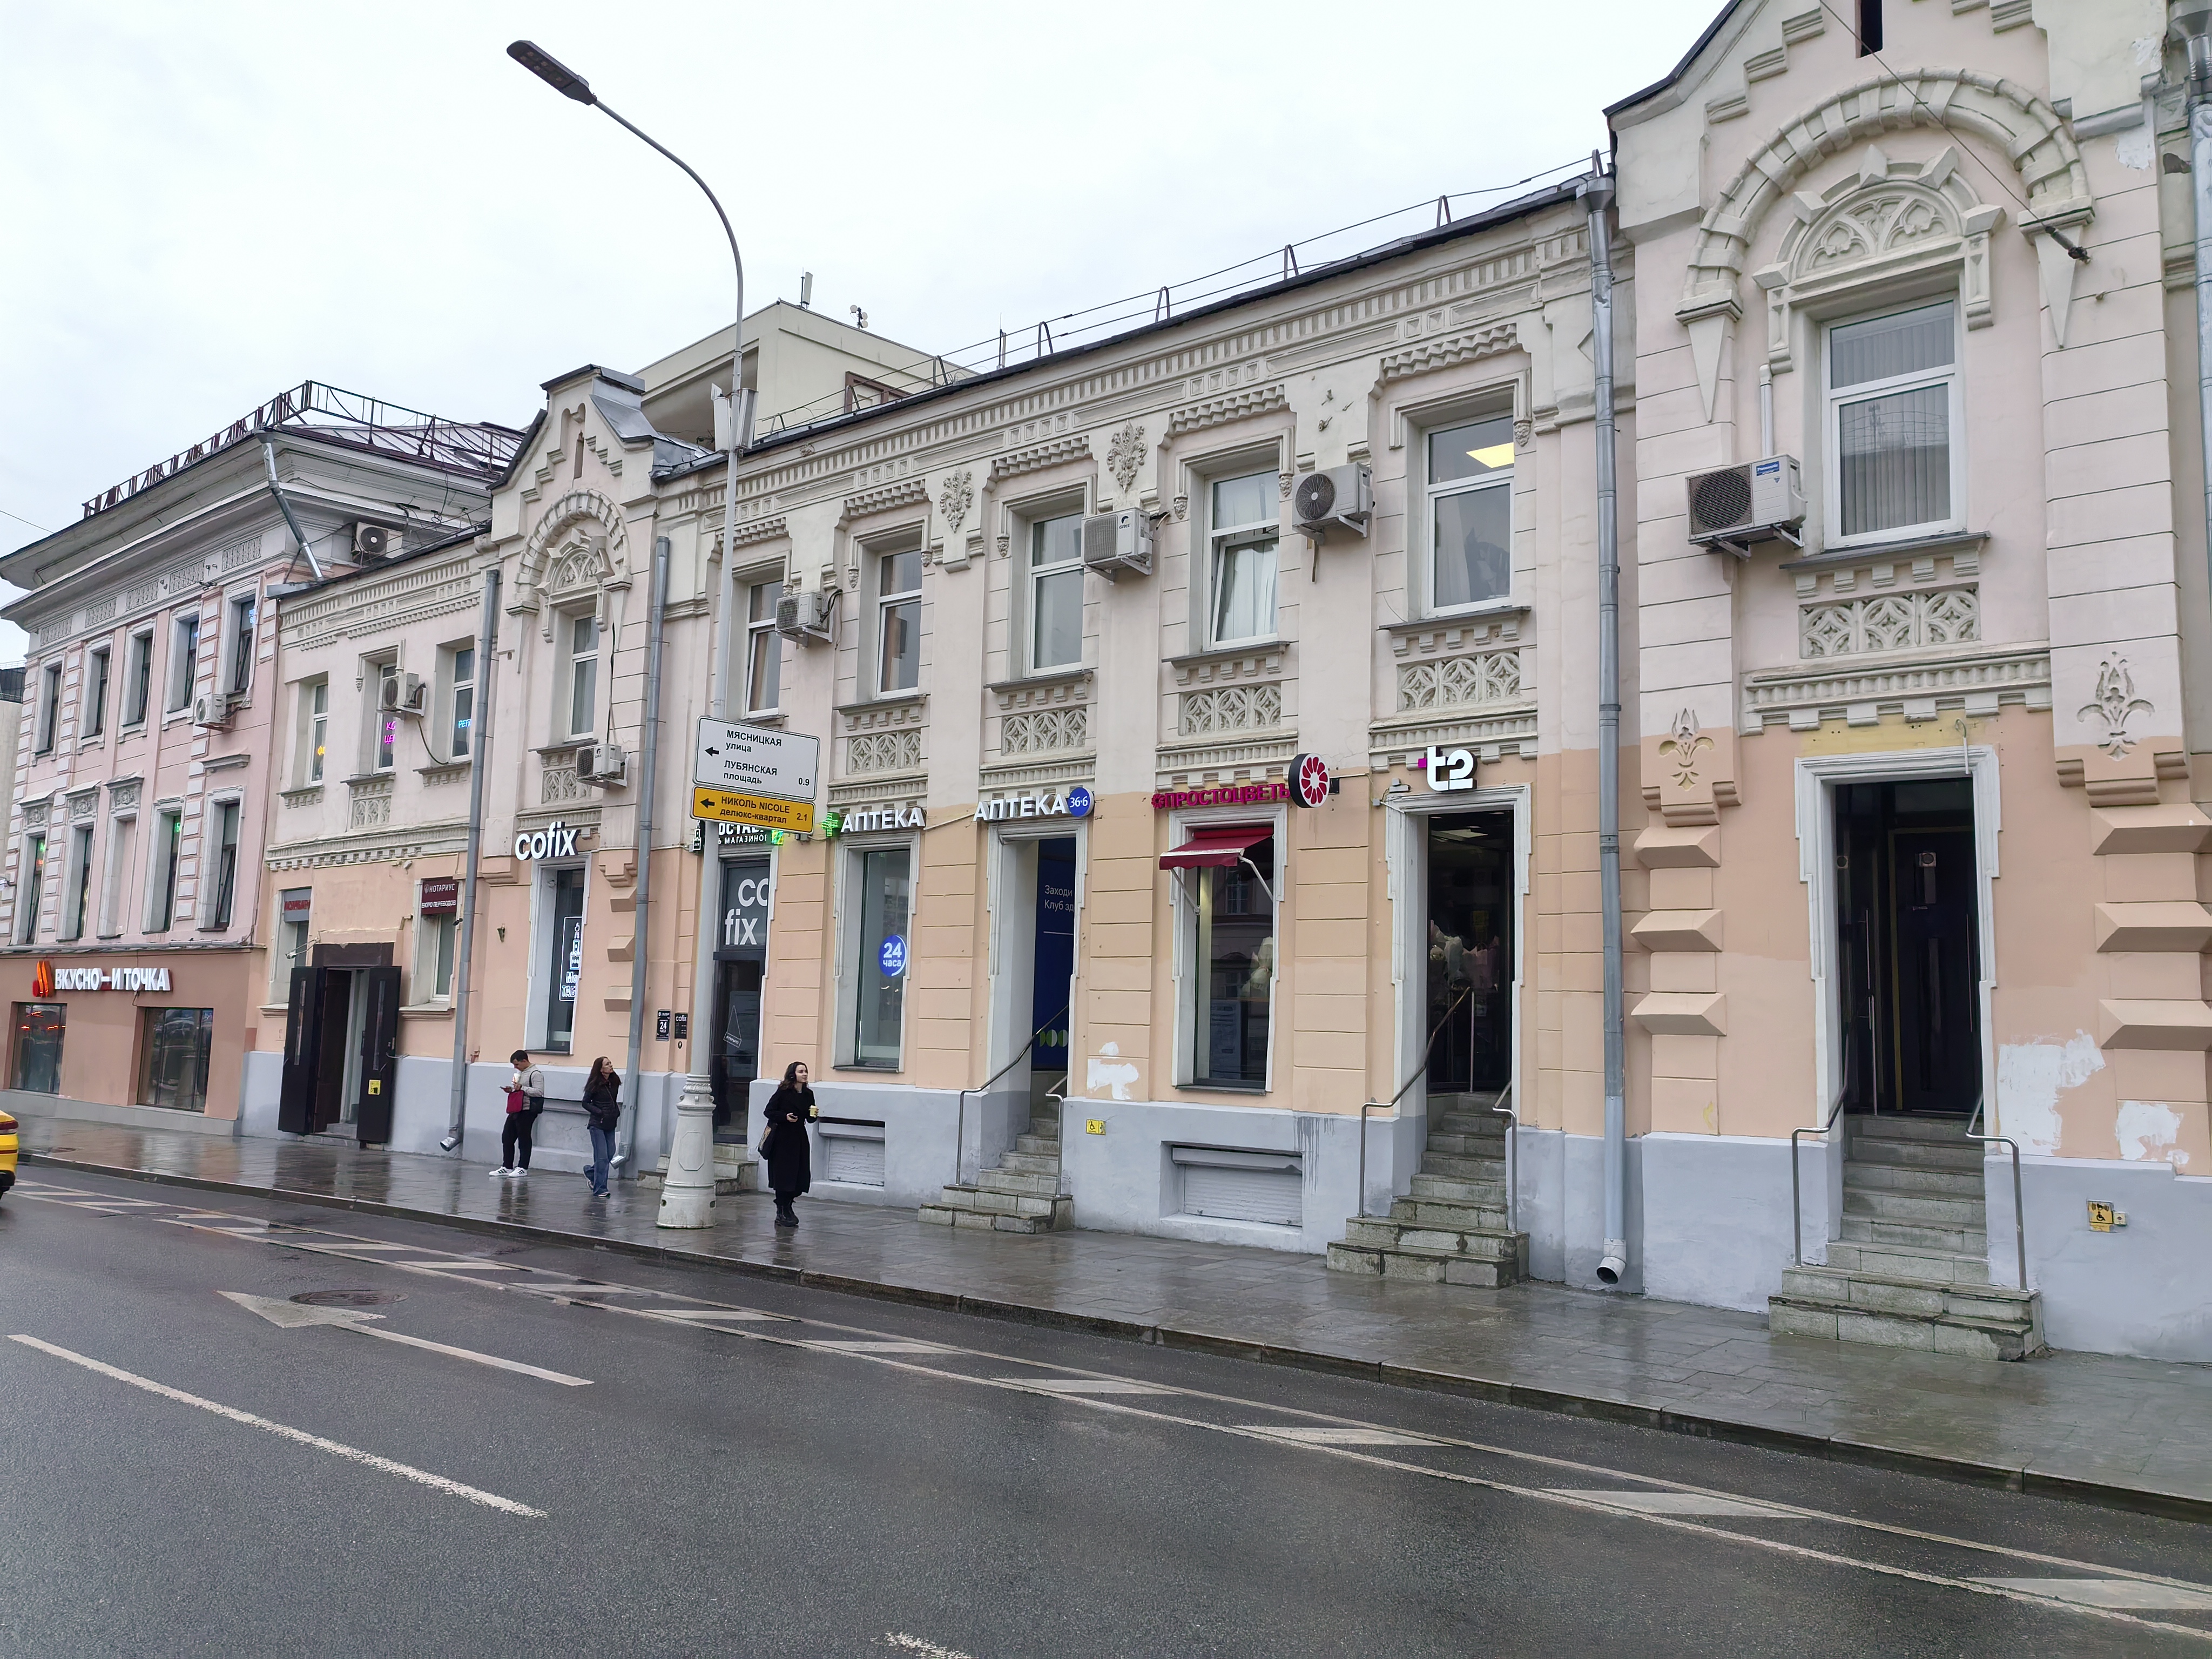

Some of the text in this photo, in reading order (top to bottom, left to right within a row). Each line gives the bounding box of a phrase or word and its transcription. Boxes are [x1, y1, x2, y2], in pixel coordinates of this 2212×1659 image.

[726, 730, 782, 746] МЯСНИЦКАЯ
[725, 742, 752, 752] улица
[724, 760, 778, 775] ЛУБЯНСКАЯ
[1418, 746, 1475, 791] t2
[723, 773, 810, 786] площадь 0.9
[721, 796, 790, 813] НИКОЛЬ NICOLE
[973, 793, 1068, 821] АПТЕКА
[719, 809, 807, 824] делюкс-квартал 2.1
[840, 807, 925, 833] АПТЕКА
[515, 821, 579, 860] cofix
[429, 884, 455, 893] НОТАРИУС
[1044, 885, 1073, 898] Заходи
[1044, 899, 1064, 912] Клуб
[725, 908, 758, 945] fix
[883, 942, 902, 959] 24
[123, 967, 171, 992] ТОЧКА
